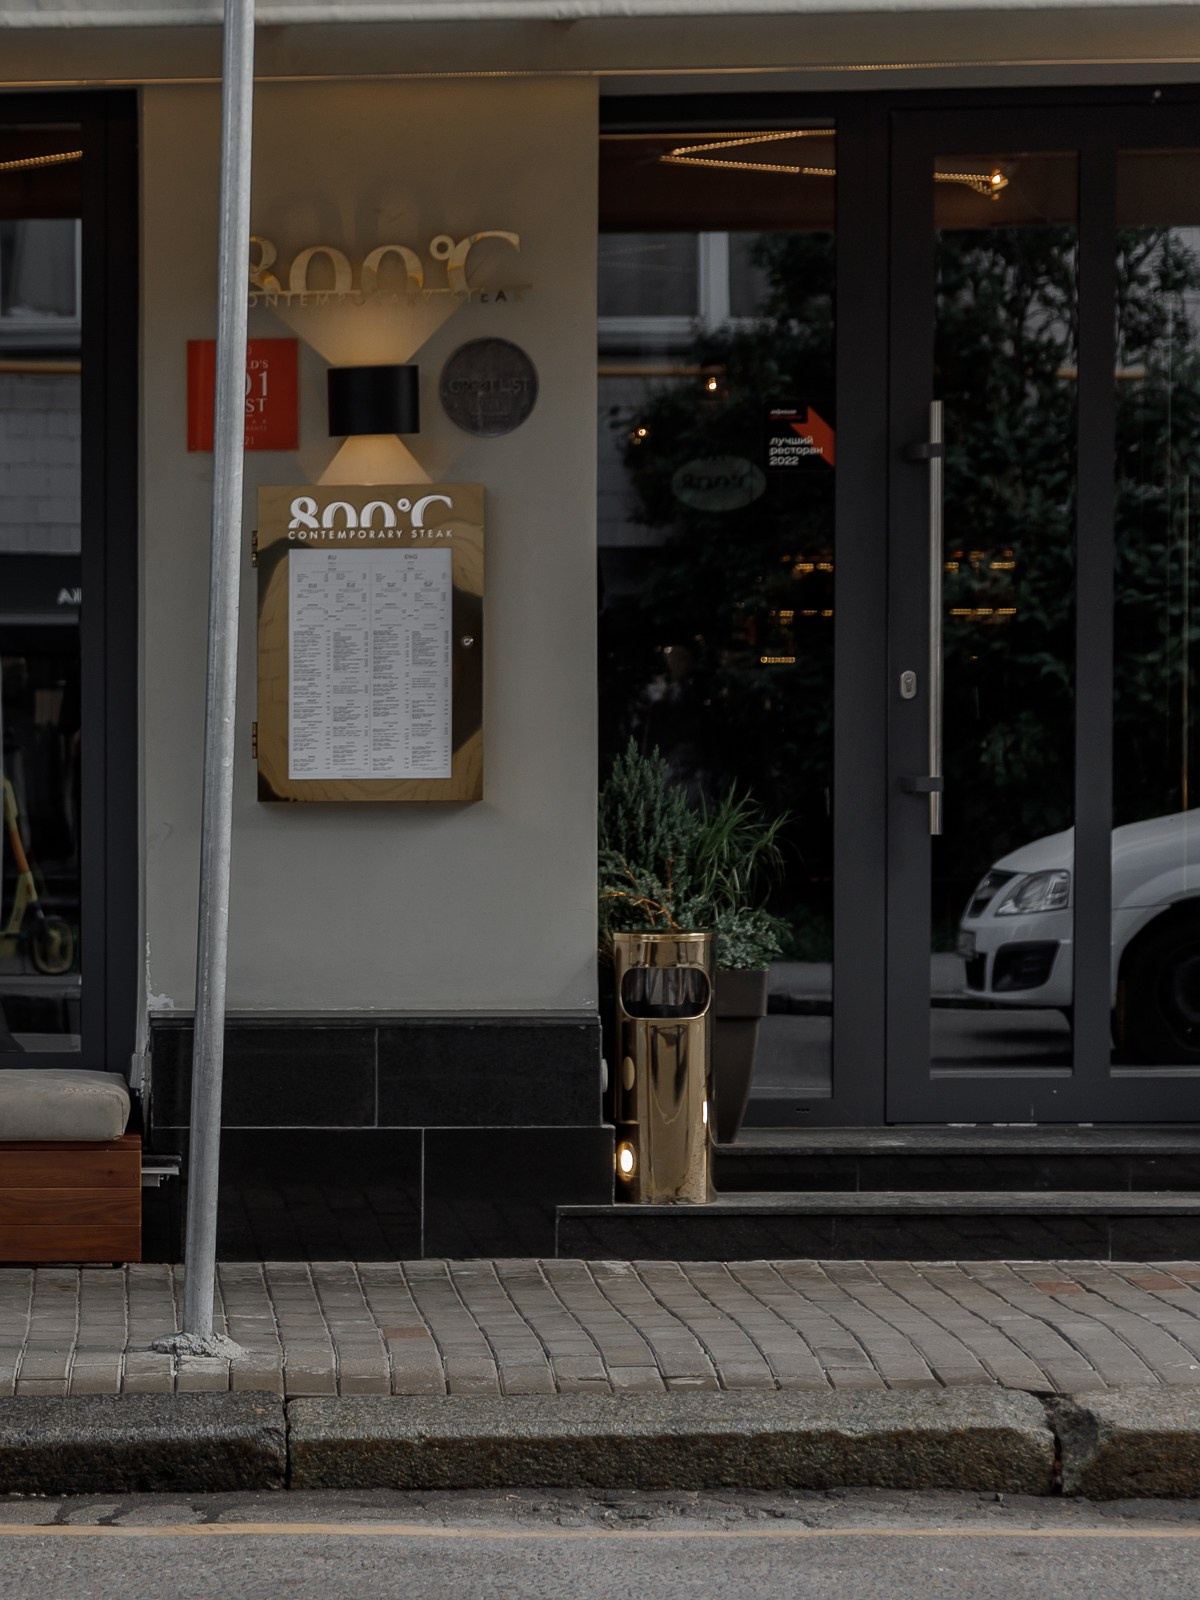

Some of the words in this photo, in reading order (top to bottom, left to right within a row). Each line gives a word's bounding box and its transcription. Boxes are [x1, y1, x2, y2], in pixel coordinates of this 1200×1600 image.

[249, 292, 431, 308] ONTEMPORARY
[245, 398, 268, 413] ST
[769, 435, 814, 447] лучший
[769, 447, 823, 457] ресторан
[769, 456, 799, 466] 2022
[288, 494, 453, 528] 800°C
[288, 529, 403, 540] CONTEMPORARY
[411, 529, 453, 539] STEAK
